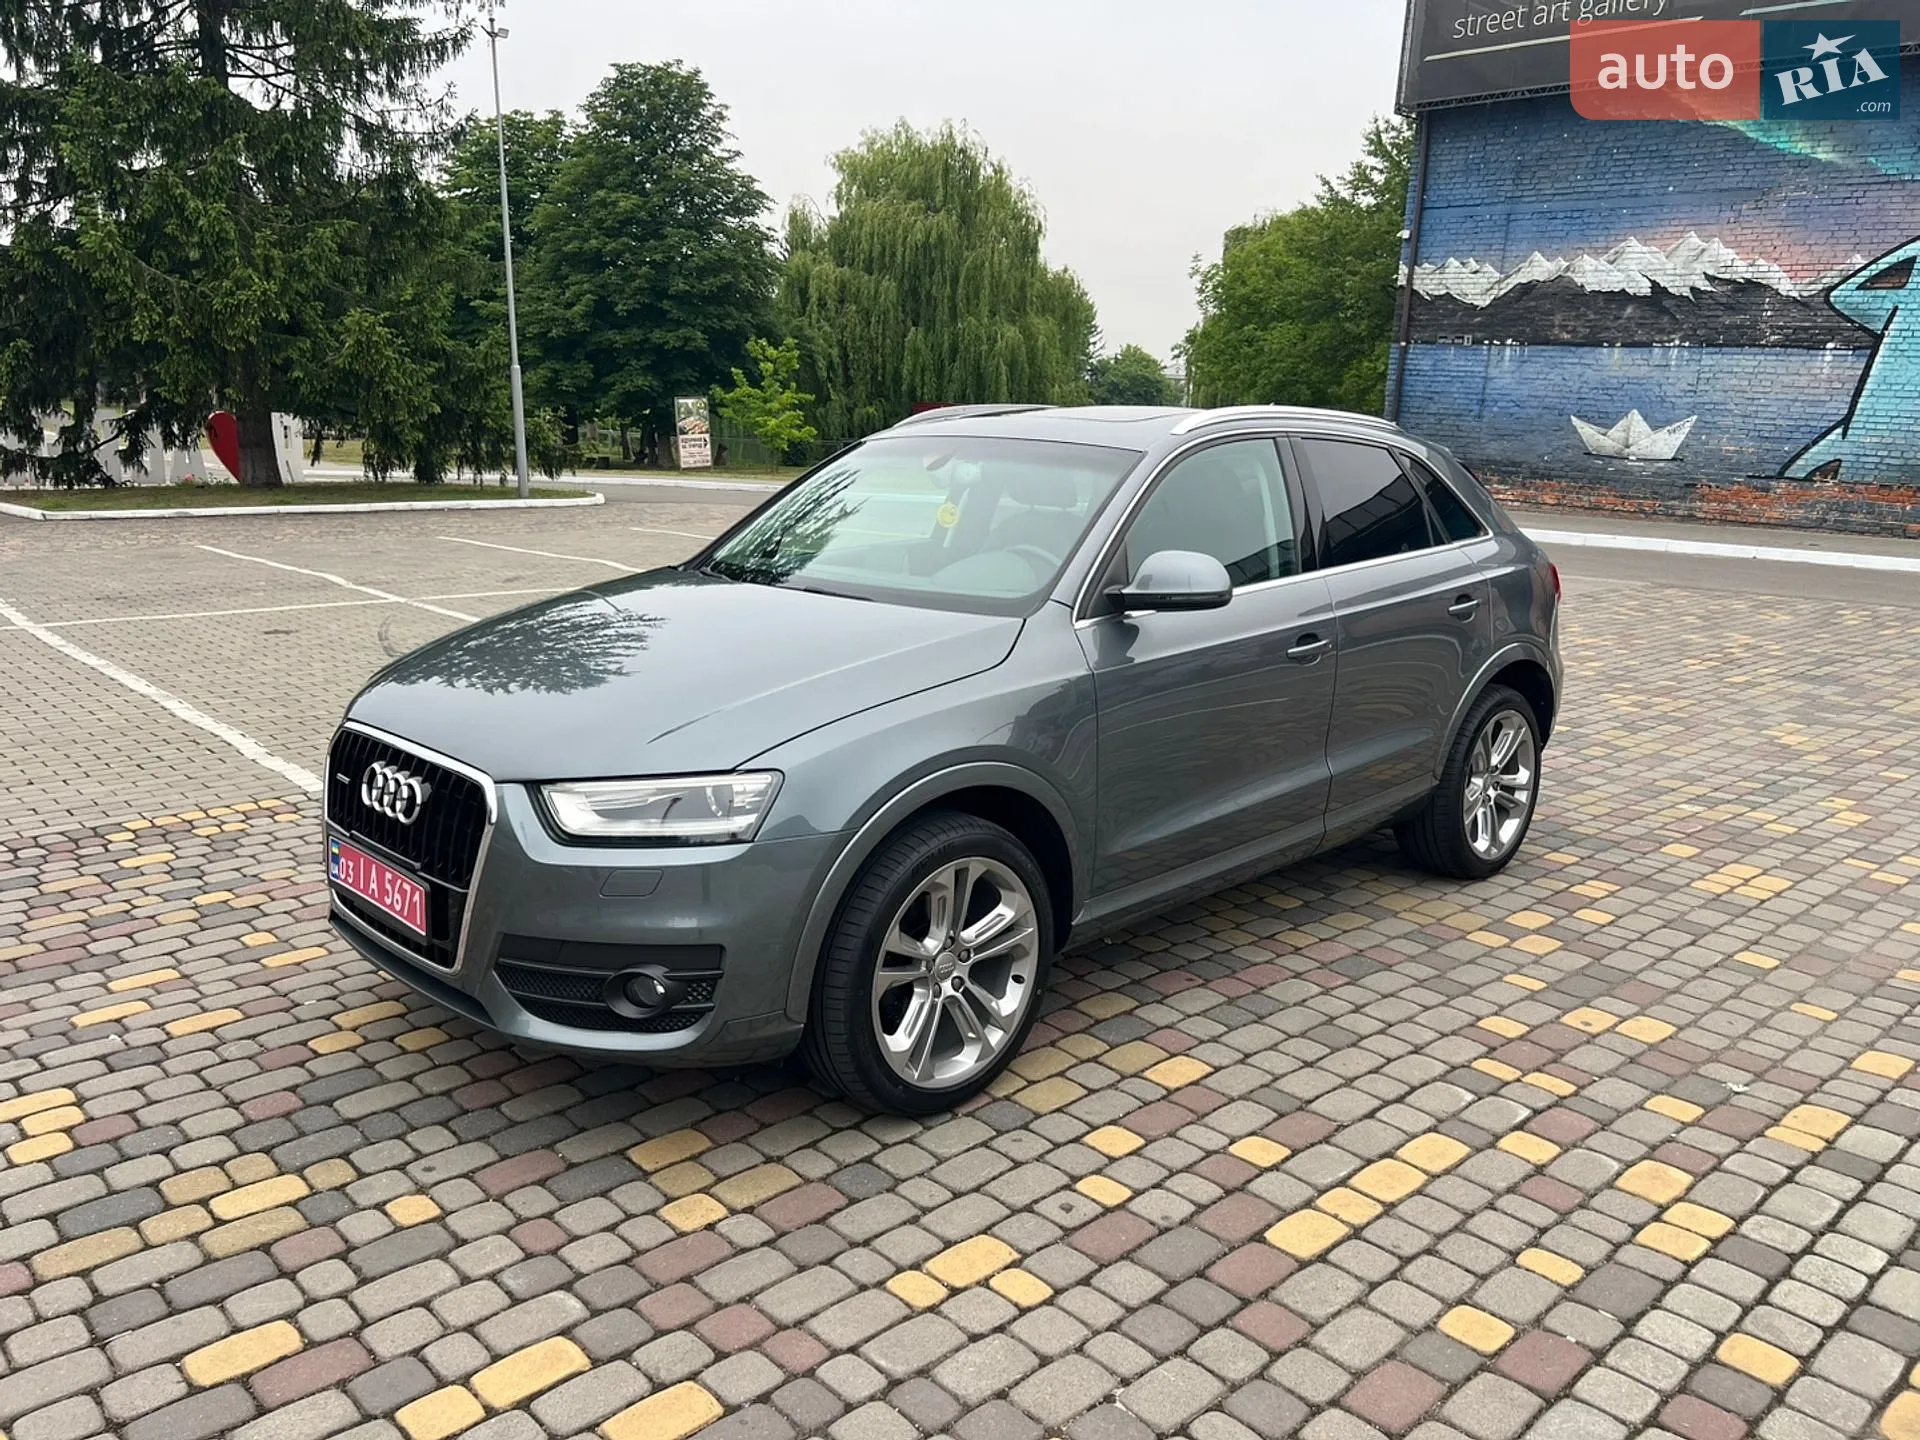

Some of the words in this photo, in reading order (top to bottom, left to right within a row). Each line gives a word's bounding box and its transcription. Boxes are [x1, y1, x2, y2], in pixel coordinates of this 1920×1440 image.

[1452, 5, 1528, 39] street
[1533, 0, 1572, 25] art
[340, 856, 355, 884] 03
[359, 857, 379, 899] IA
[384, 871, 421, 925] 5671
